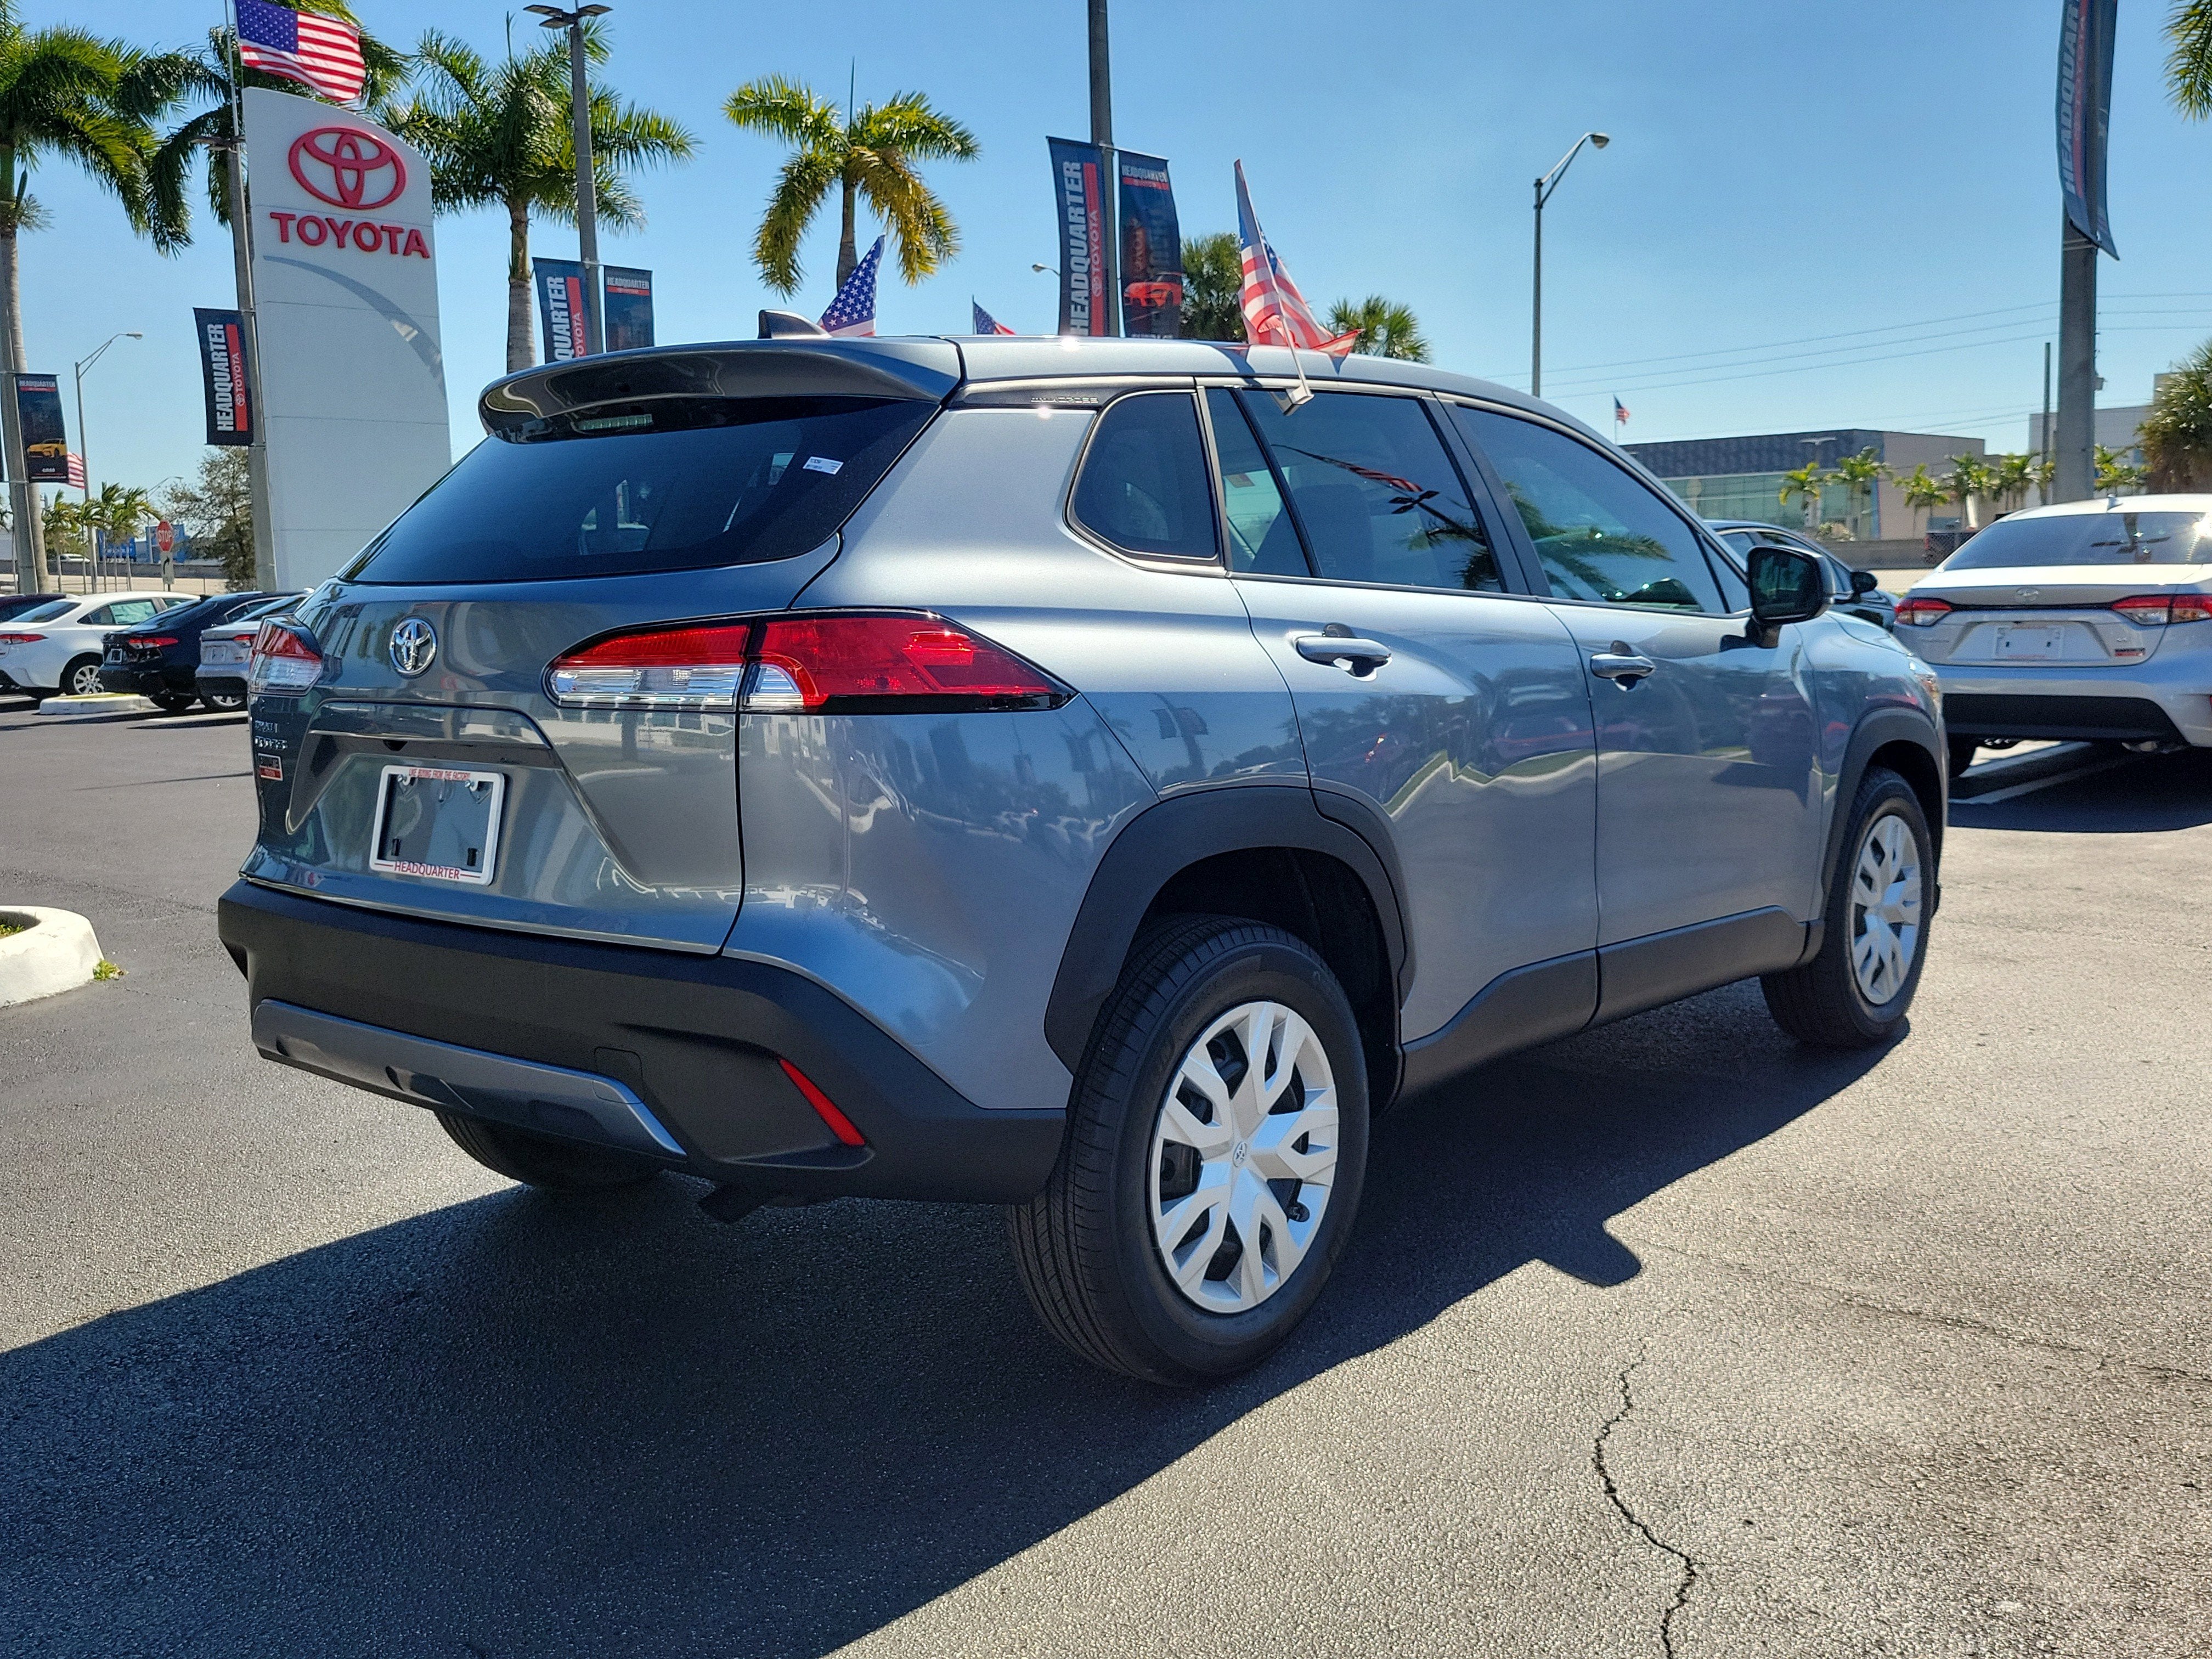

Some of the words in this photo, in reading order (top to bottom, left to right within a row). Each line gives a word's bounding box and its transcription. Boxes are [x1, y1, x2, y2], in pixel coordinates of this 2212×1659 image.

[2061, 0, 2078, 194] HEADQUAR
[270, 212, 430, 258] TOYOTA
[1063, 161, 1090, 336] HEADQUARTER
[1090, 210, 1102, 273] TOYOTA
[607, 276, 650, 290] HEADQUARTER
[207, 323, 234, 432] HEADQUARTER
[233, 352, 244, 392] TOYOTA
[158, 529, 172, 543] STOP
[394, 861, 460, 879] HEADQUARTER
